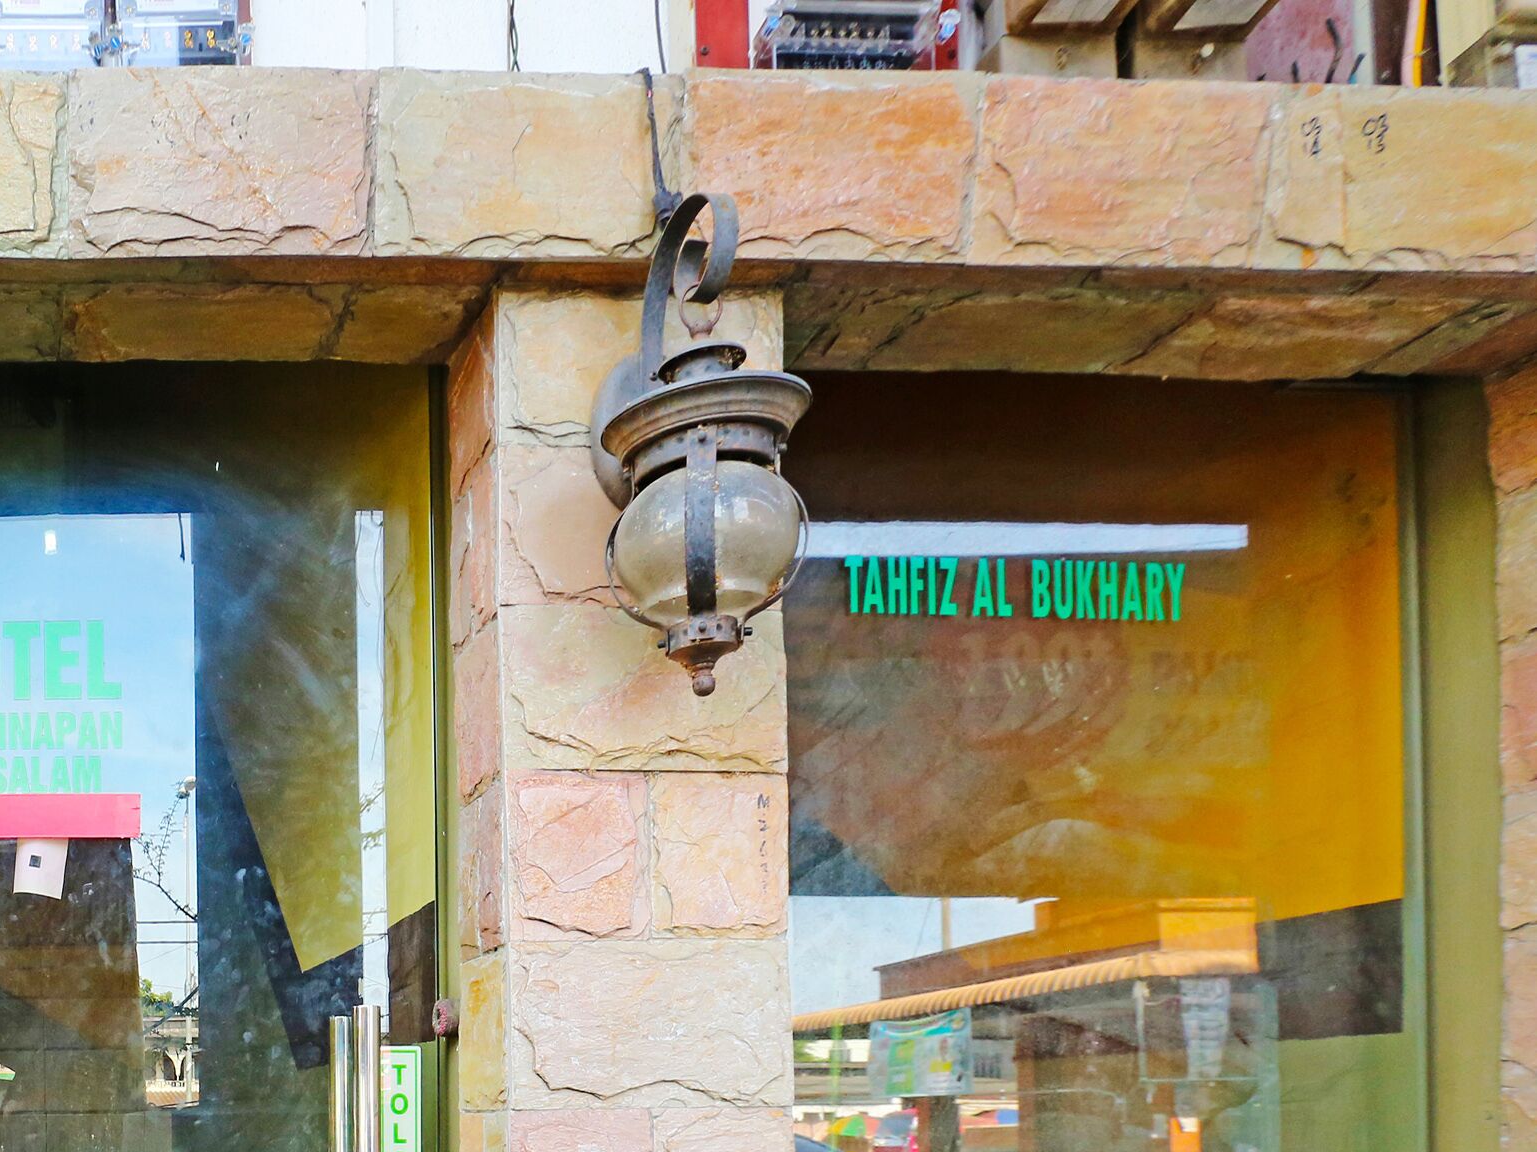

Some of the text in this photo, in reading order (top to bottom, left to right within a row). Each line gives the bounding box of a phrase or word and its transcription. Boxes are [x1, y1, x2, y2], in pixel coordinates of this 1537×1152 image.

[844, 554, 1185, 621] TAHFIZ AL BUKHARY
